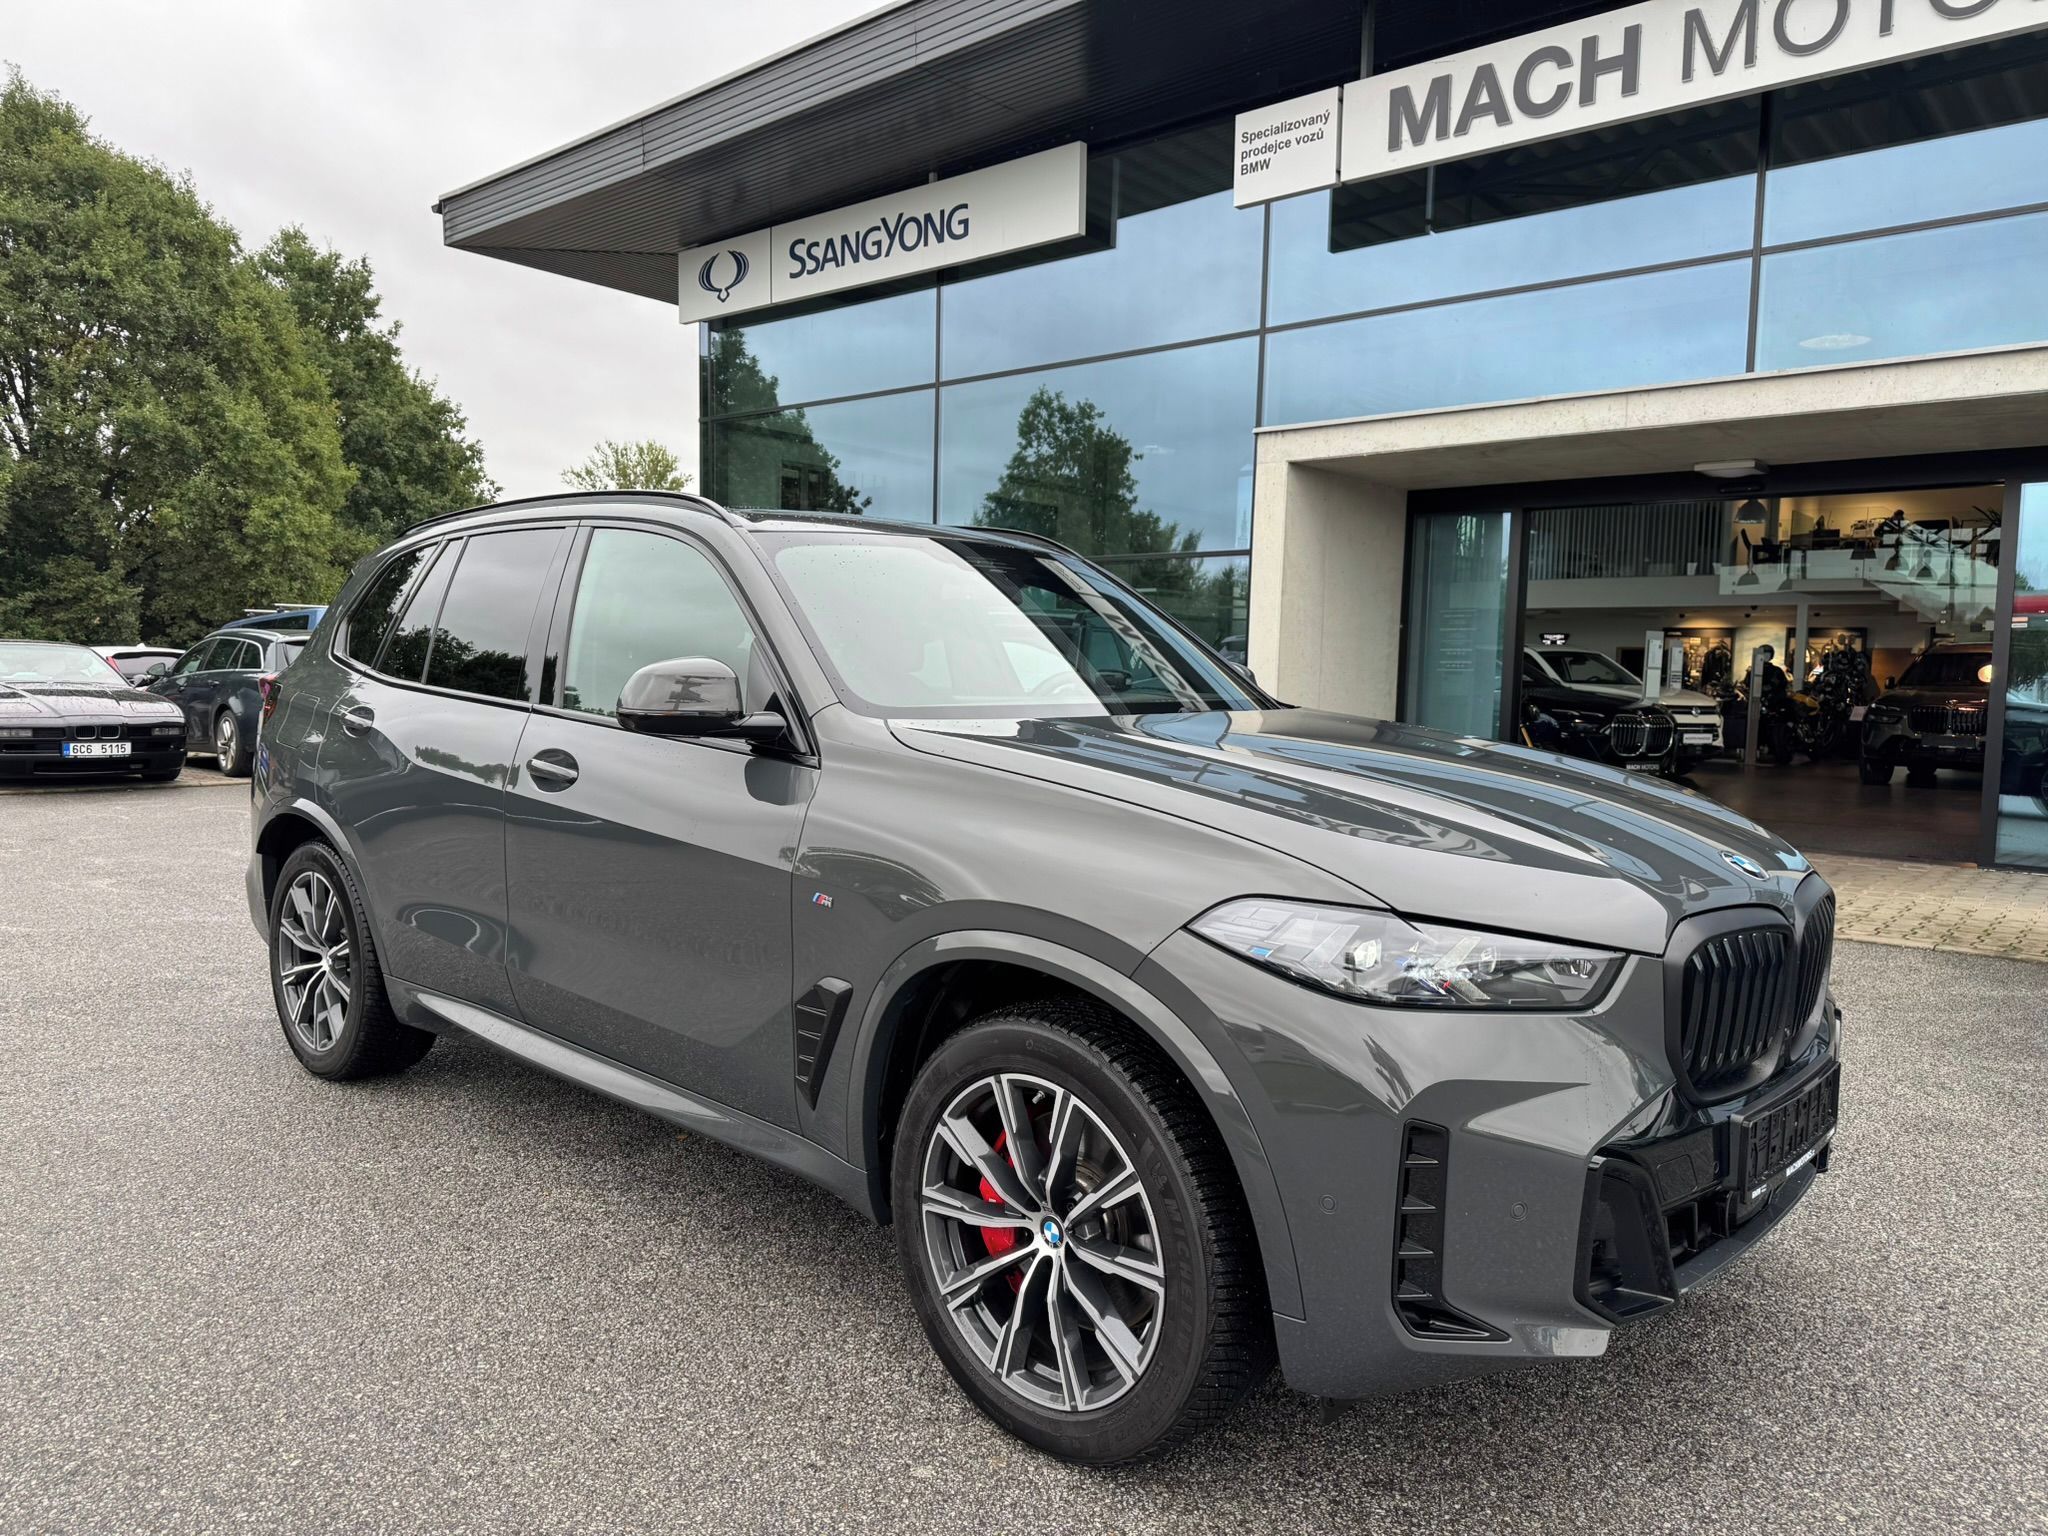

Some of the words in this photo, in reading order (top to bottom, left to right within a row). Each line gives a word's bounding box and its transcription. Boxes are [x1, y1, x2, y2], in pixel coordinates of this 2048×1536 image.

[1388, 23, 1642, 152] MACH
[1241, 109, 1331, 144] Specializovaný
[1241, 139, 1292, 162] prodejce
[1241, 157, 1271, 175] BMW
[72, 744, 93, 754] 6C6
[101, 743, 127, 754] 5115
